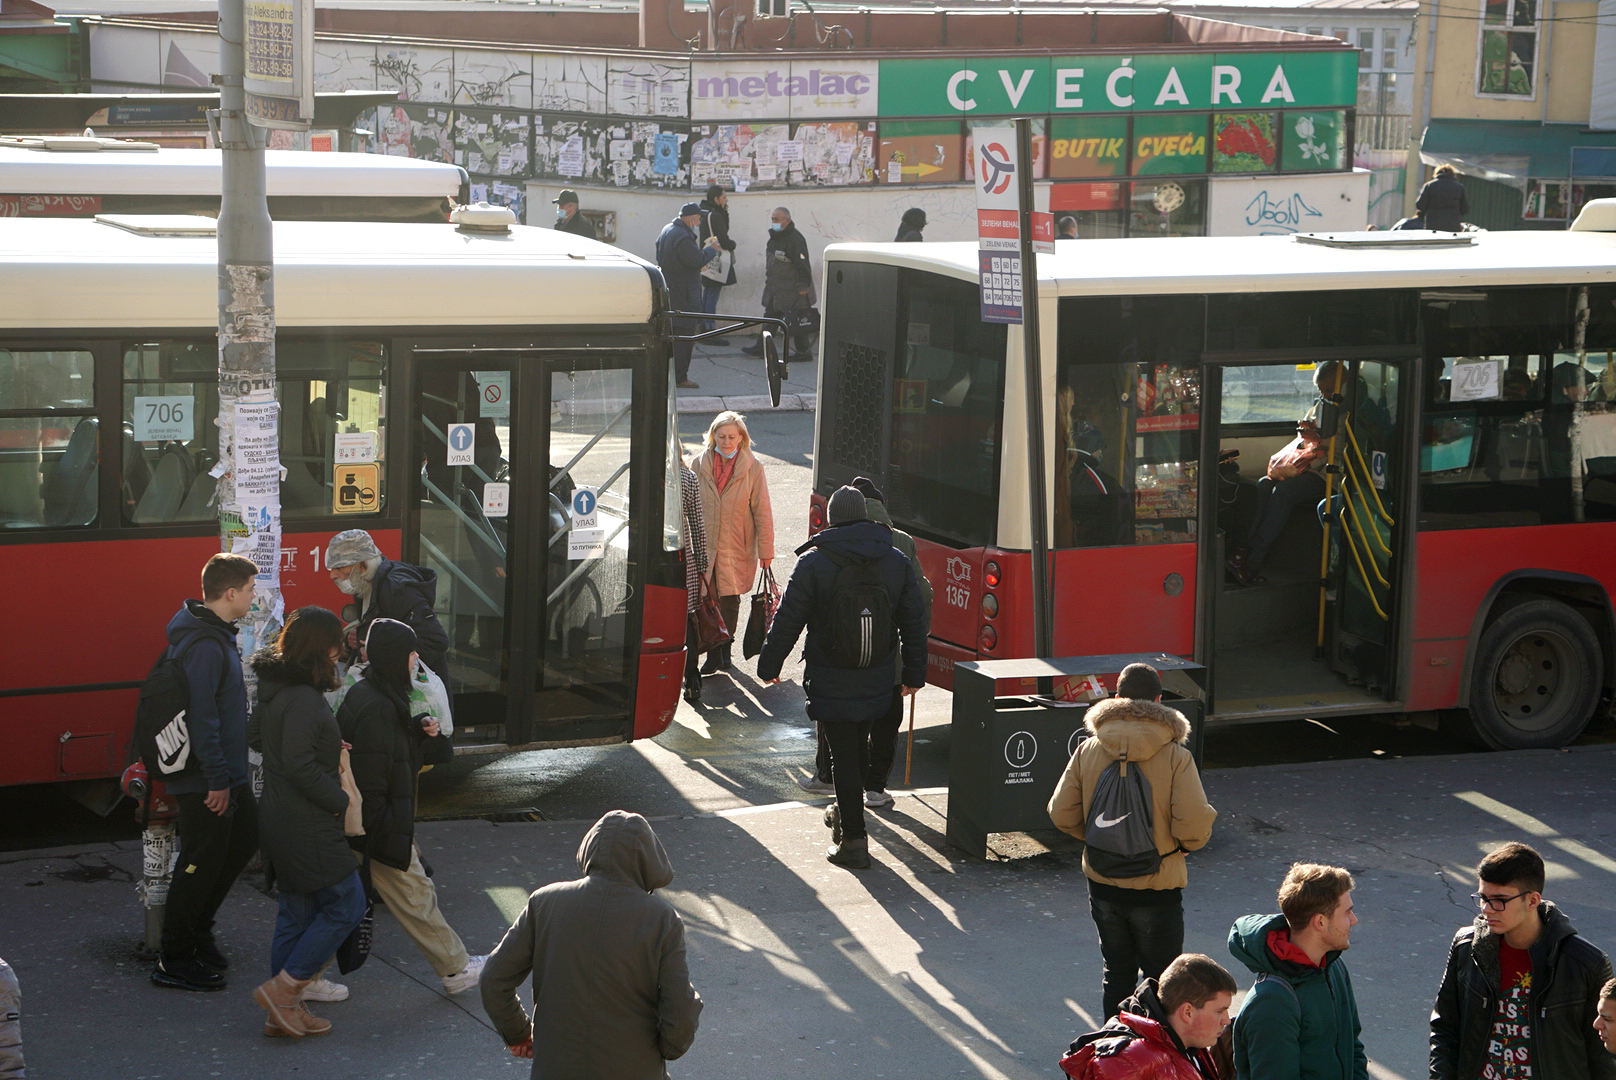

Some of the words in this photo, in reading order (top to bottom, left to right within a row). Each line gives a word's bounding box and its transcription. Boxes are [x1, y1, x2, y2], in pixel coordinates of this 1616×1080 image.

[254, 6, 293, 20] Aleksandra
[256, 24, 292, 39] 324-92-62
[256, 42, 292, 57] 245-99-77
[256, 61, 292, 75] 242-39-59
[699, 70, 871, 98] metalac
[947, 58, 1295, 111] CVEĆARA
[262, 99, 278, 118] 99
[1052, 138, 1125, 159] BUTIK
[1137, 132, 1206, 157] CVEĆA
[981, 220, 1002, 228] ЗЕЛЕНИ
[1045, 221, 1051, 236] 1
[986, 240, 1002, 248] ZELENI
[1002, 241, 1017, 249] VENAC
[993, 261, 999, 269] 15
[1003, 261, 1009, 269] 60
[1013, 262, 1019, 270] 67
[994, 277, 1000, 285] 71
[1003, 277, 1010, 285] 72
[1013, 278, 1020, 286] 75
[985, 293, 991, 301] 84
[993, 293, 1002, 301] 704
[1003, 294, 1012, 302] 706
[1013, 295, 1021, 303] 707
[1461, 364, 1491, 389] 706
[146, 403, 184, 424] 706
[239, 407, 263, 415] Позивају
[576, 519, 595, 527] УЛАЗ
[945, 585, 970, 609] 1367
[1004, 777, 1034, 785] АМБАЛАЖА
[1493, 1022, 1531, 1038] THE
